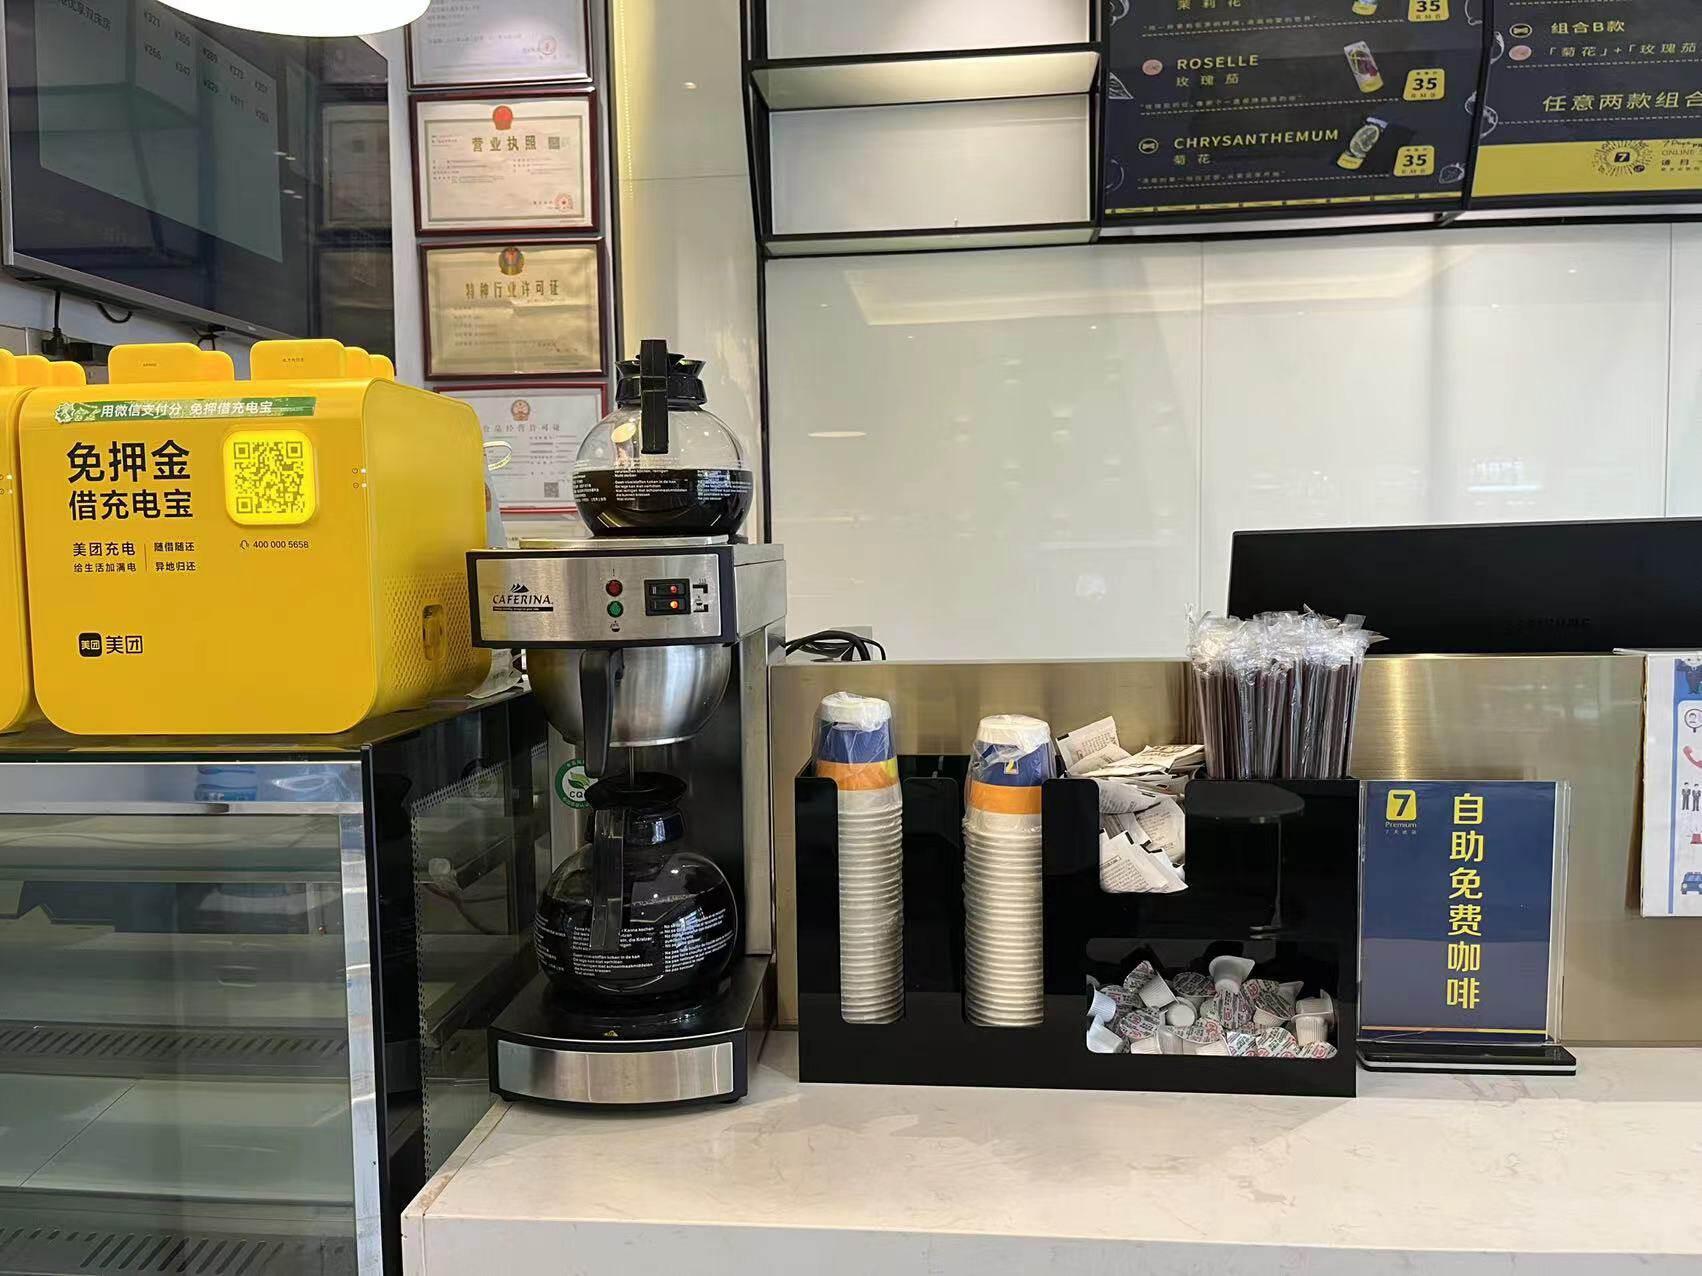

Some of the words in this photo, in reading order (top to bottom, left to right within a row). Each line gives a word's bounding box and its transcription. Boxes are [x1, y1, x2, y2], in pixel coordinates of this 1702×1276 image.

[1415, 0, 1441, 12] 35
[1551, 20, 1625, 35] 组合B款
[1176, 54, 1260, 70] ROSELLE
[1175, 73, 1240, 88] 玫瑰茄
[1412, 77, 1438, 91] 35
[1542, 91, 1702, 112] 任意两款组合
[472, 135, 537, 153] 营业执照
[1173, 128, 1340, 150] CHRYSANTHEMUM
[1173, 153, 1211, 166] 菊花
[1402, 153, 1428, 167] 35
[1617, 152, 1628, 161] 7
[465, 279, 560, 299] 特种行业许可证
[100, 403, 182, 419] 用微信支付分
[189, 400, 273, 416] 免押借充电宝
[66, 439, 191, 483] 免押金
[68, 488, 194, 521] 借充电宝
[72, 541, 137, 558] 美团充电
[153, 541, 195, 552] 随借随还
[252, 541, 268, 550] 400
[269, 541, 284, 550] 000
[285, 540, 309, 549] 5658
[73, 562, 137, 573] 给生活加满电
[155, 560, 196, 572] 异地归还
[492, 594, 552, 605] CAFERINA
[80, 639, 100, 650] 美团
[105, 635, 143, 655] 美团
[569, 790, 584, 799] CQ
[1392, 793, 1412, 817] 7
[1384, 821, 1418, 829] Premium
[1446, 792, 1485, 1010] 自助免费咖啡
